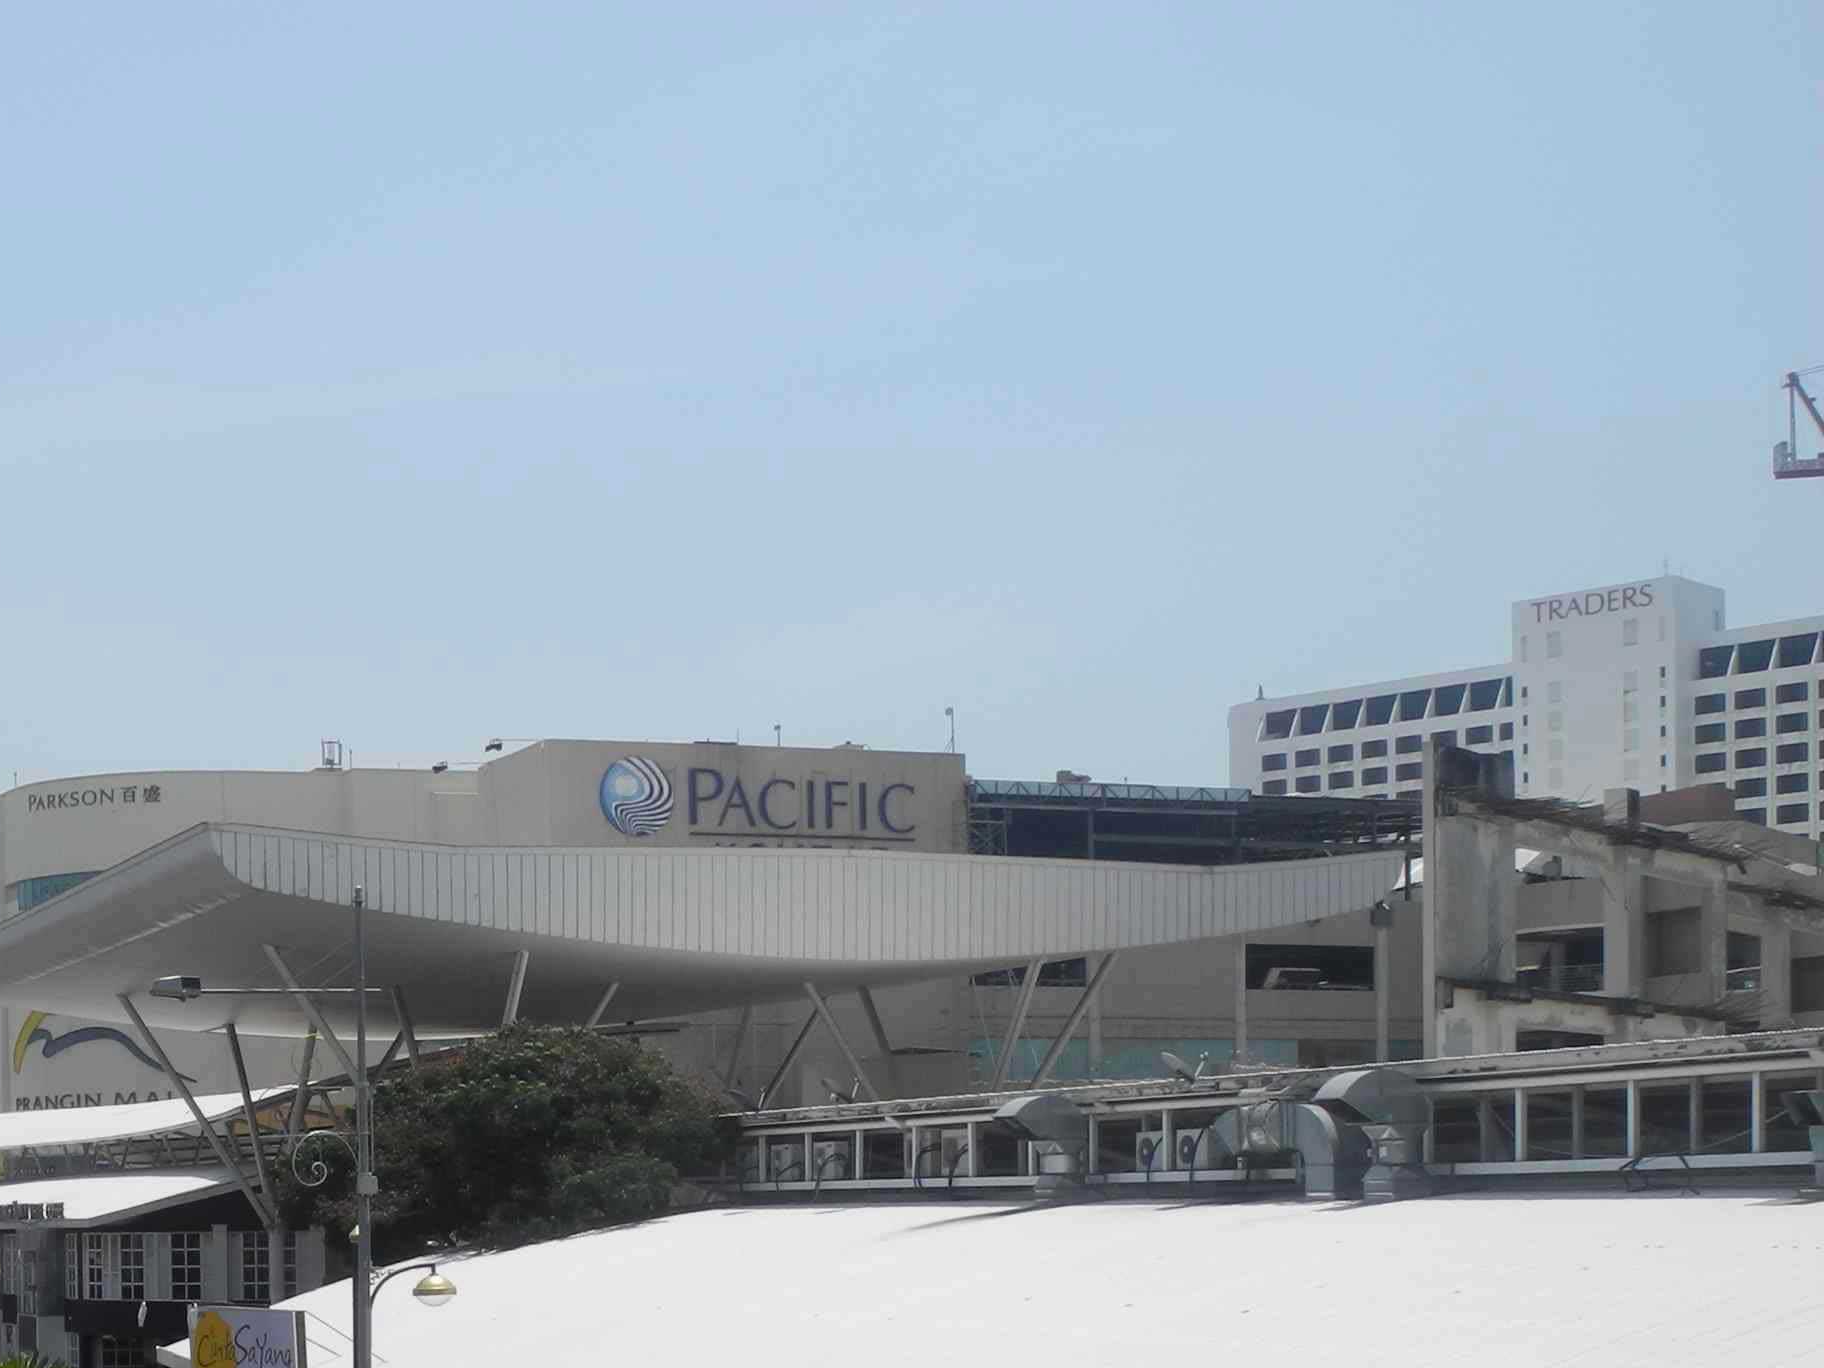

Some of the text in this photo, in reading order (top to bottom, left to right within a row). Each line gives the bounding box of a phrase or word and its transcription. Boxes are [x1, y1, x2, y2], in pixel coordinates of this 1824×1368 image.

[1530, 584, 1653, 622] TRADERS
[28, 788, 114, 814] PARKSON
[120, 785, 161, 804] 百盛
[688, 767, 916, 834] PACIFIC
[16, 1092, 102, 1111] PRANGIN
